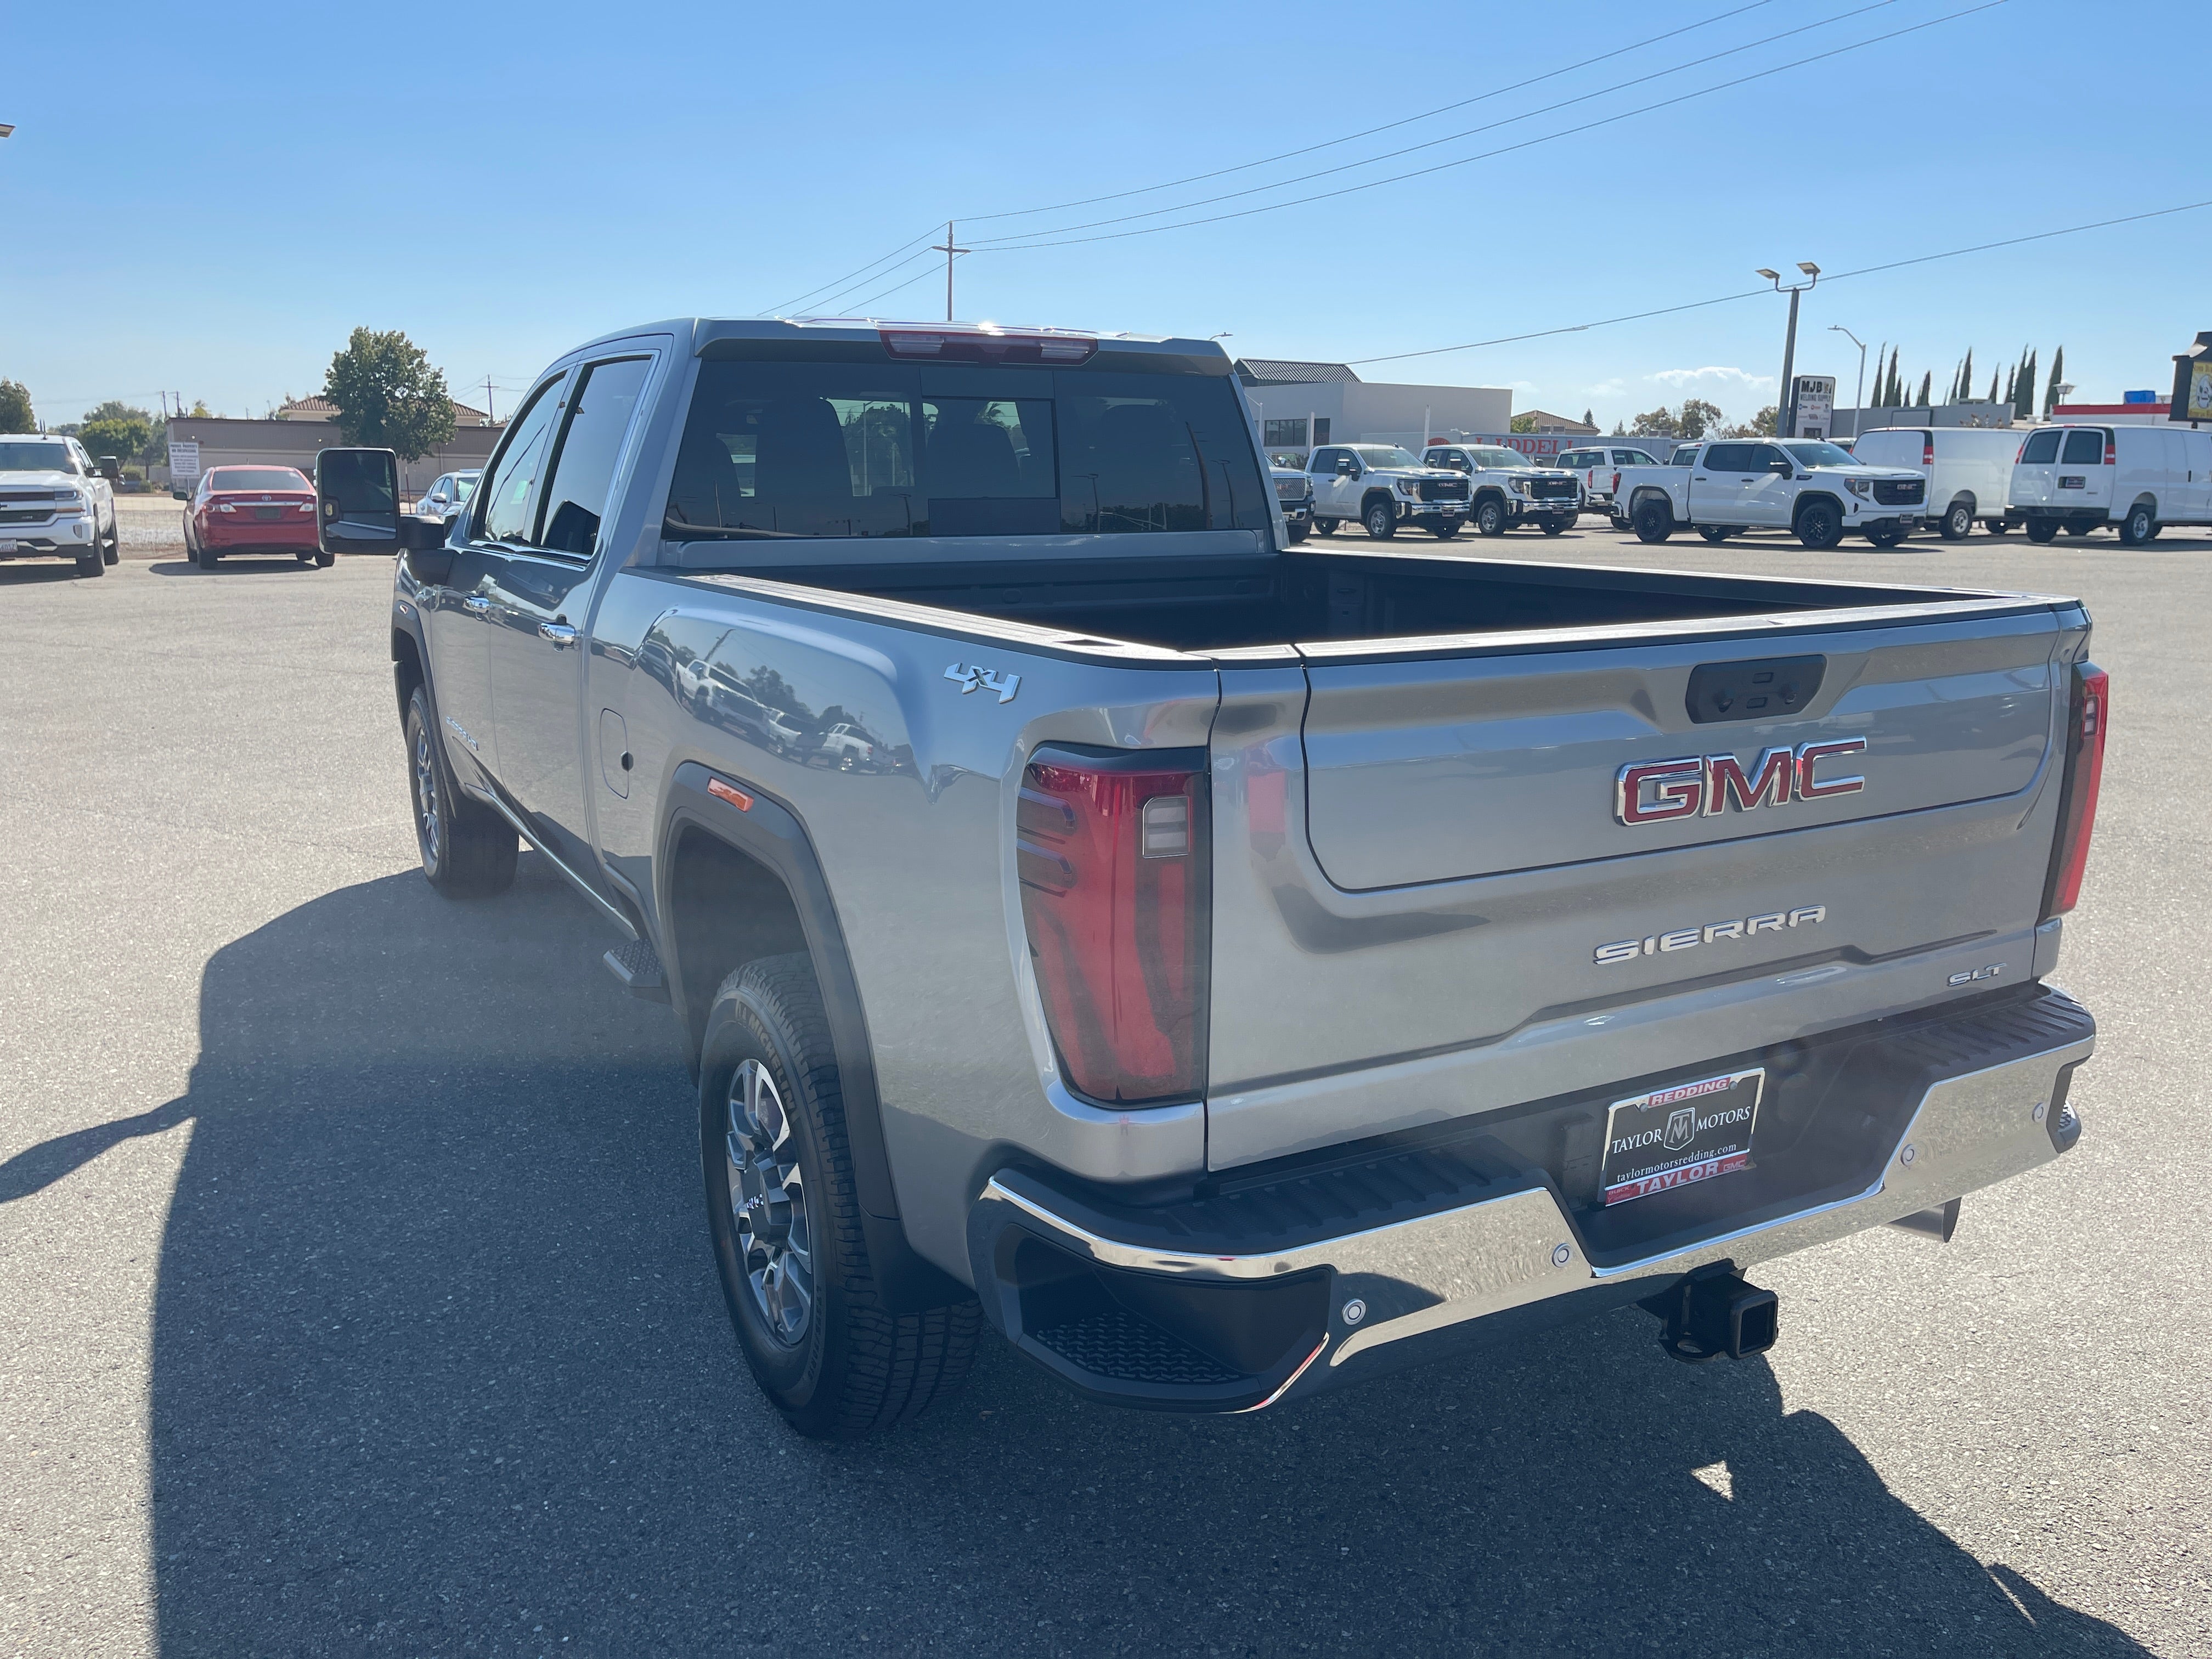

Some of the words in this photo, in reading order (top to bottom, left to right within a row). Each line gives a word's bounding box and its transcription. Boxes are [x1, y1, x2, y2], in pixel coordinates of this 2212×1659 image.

[1801, 380, 1822, 393] MJB
[1614, 736, 1867, 827] GMC
[1594, 904, 1826, 965] SIERRA
[1948, 962, 2007, 986] SLT
[748, 1012, 797, 1111] MICHELIN
[1651, 1079, 1728, 1106] REDDING
[1612, 1128, 1662, 1154] TAYLOR
[1695, 1106, 1751, 1132] MOTORS
[1609, 1186, 1629, 1195] BUICK
[1637, 1161, 1719, 1195] TAYLOR
[1723, 1159, 1746, 1172] GMC
[1617, 1143, 1737, 1182] taylormotorsredding.com
